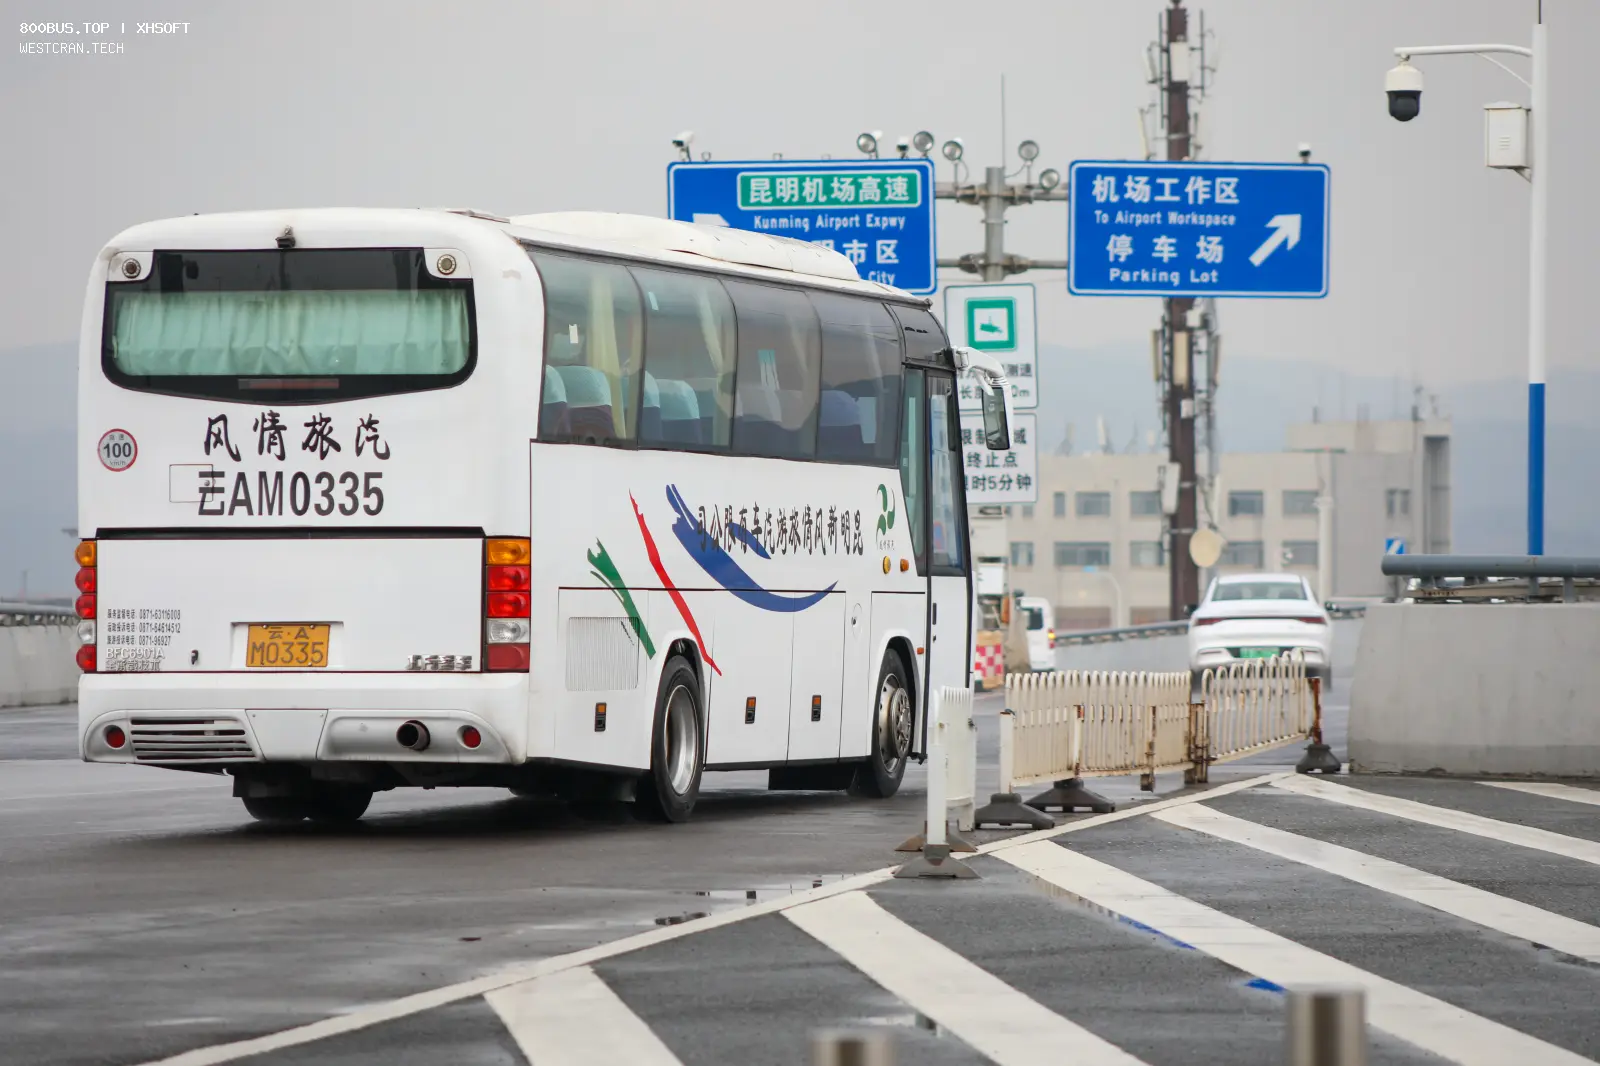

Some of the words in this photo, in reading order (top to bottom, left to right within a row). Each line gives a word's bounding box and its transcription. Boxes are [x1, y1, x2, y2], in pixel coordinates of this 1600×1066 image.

[749, 176, 910, 204] 昆明机场高速
[1092, 174, 1240, 204] 机场工作区
[754, 215, 810, 232] Kunming
[815, 213, 860, 230] Airport
[865, 211, 906, 229] Expwy
[1095, 210, 1109, 224] To
[1115, 211, 1162, 227] Airport
[1168, 212, 1236, 228] Workspace
[1106, 234, 1224, 264] 停车场
[868, 270, 896, 286] City
[1109, 268, 1180, 286] Parking
[1190, 269, 1218, 284] Lot
[203, 410, 391, 462] 风情旅汽
[104, 443, 131, 458] 100
[966, 451, 1018, 468] 终止点
[198, 471, 384, 516] 云AM0335
[106, 648, 165, 660] BFC6901A
[250, 641, 324, 666] M0335
